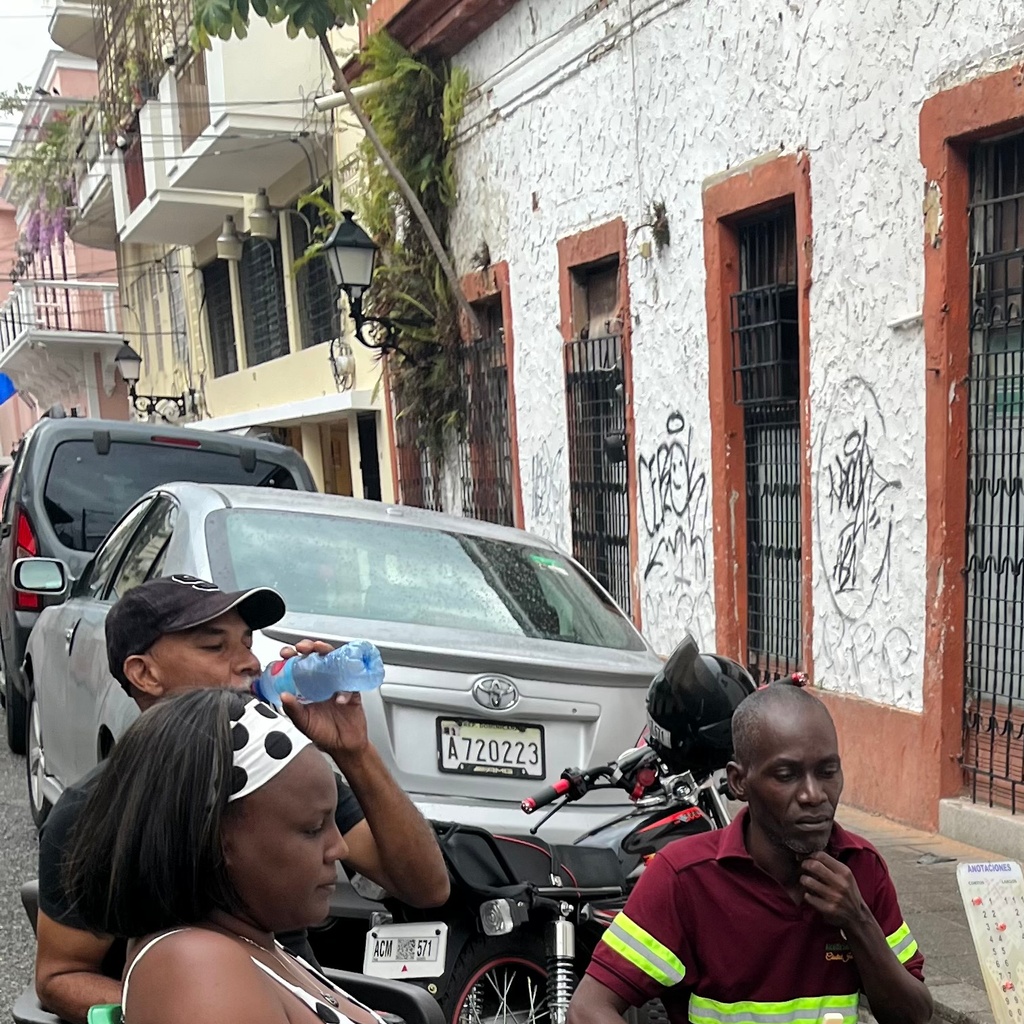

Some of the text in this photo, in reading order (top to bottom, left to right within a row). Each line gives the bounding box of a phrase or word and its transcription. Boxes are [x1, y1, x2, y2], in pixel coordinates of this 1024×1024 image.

[448, 736, 538, 765] A720223
[968, 864, 1012, 873] ANOTACIONES
[374, 940, 432, 957] ACM 571
